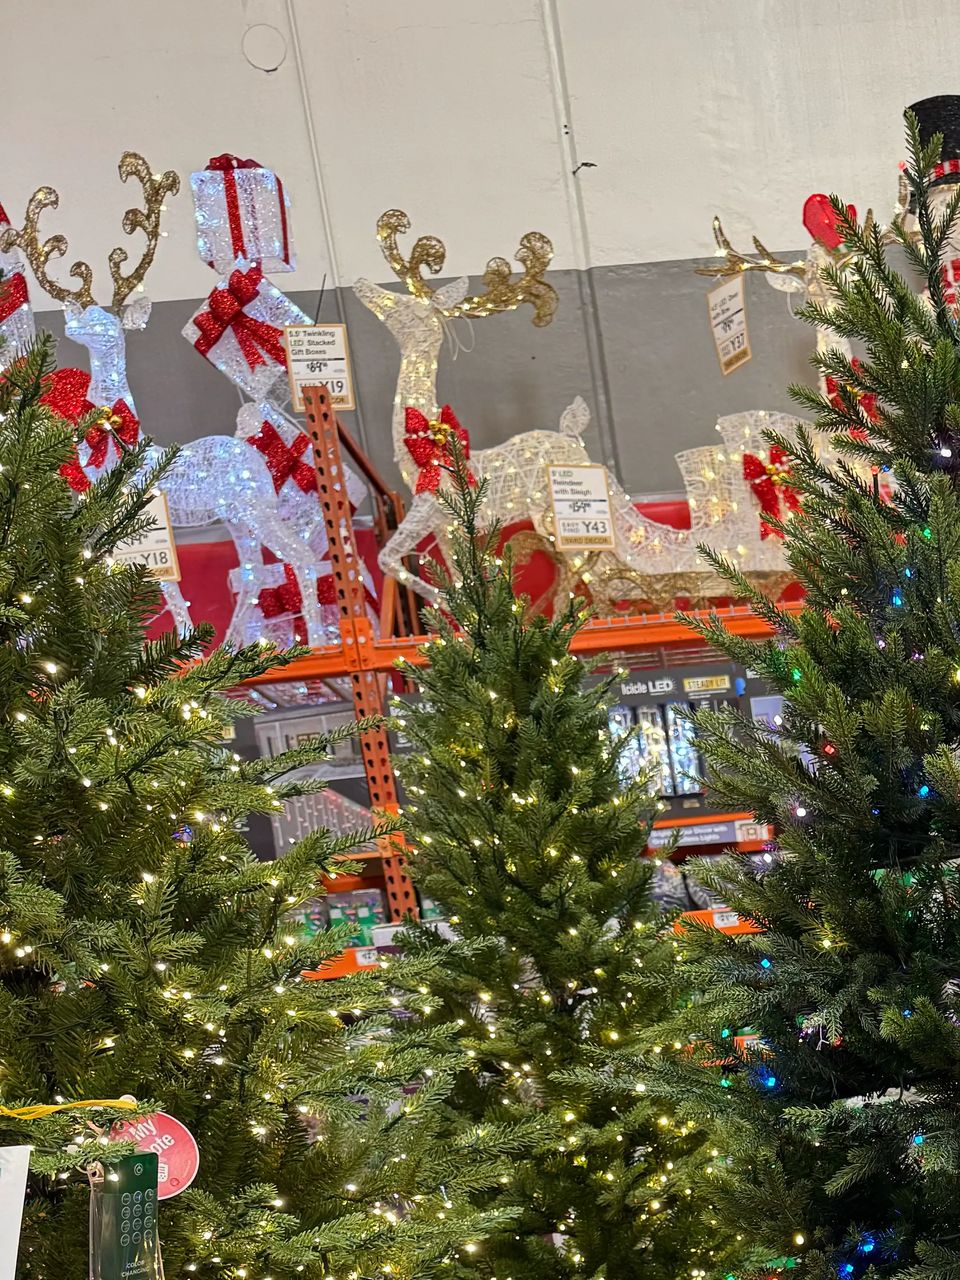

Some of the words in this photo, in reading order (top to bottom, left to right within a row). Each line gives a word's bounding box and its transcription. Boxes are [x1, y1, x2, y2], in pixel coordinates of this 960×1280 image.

[303, 330, 336, 338] Twinkling
[582, 521, 608, 534] Y43
[140, 552, 168, 566] Y18
[621, 682, 648, 696] Icicle
[649, 680, 674, 692] LED
[688, 678, 714, 690] STEADY
[715, 677, 728, 688] LIT
[125, 1260, 145, 1270] COLOR
[121, 1266, 150, 1278] CHANGING
